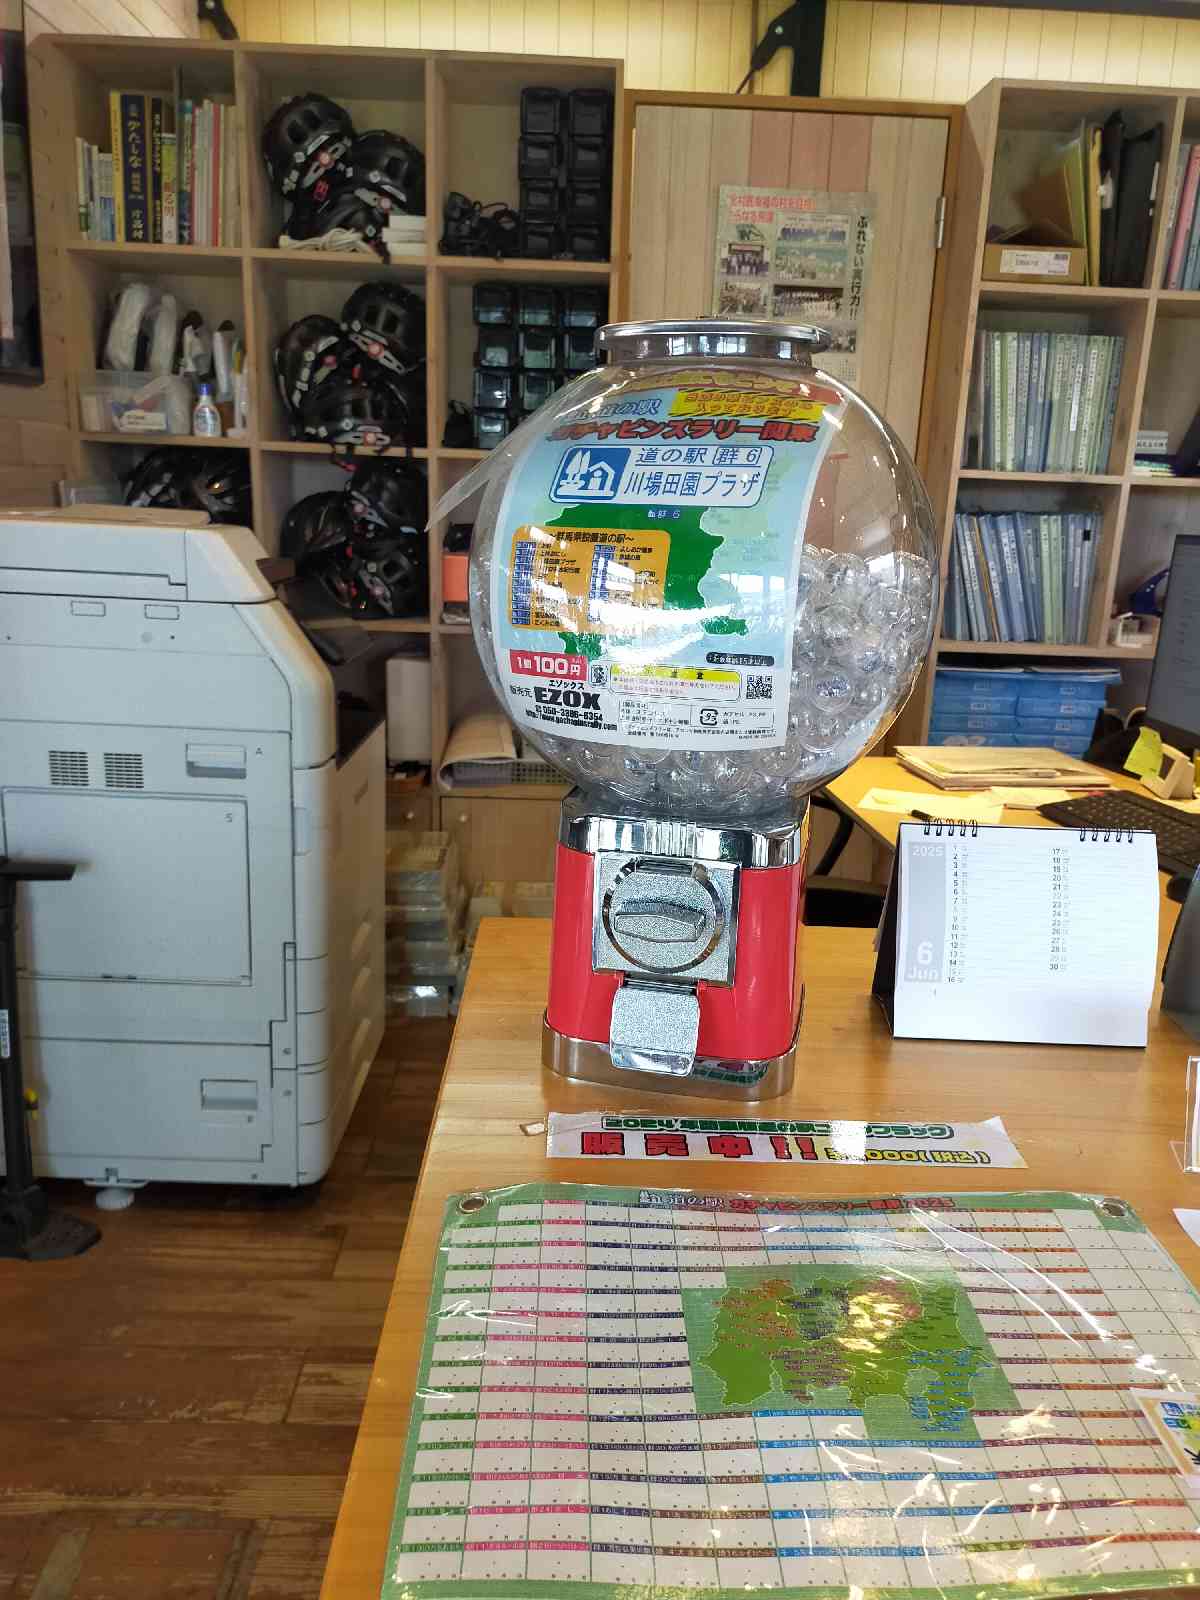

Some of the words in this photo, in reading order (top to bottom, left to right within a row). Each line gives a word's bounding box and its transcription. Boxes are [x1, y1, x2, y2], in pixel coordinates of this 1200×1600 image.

[636, 446, 708, 465] 道の駅
[623, 470, 762, 497] 川場田園プラザ
[533, 686, 601, 711] EZOX
[911, 845, 944, 857] 2025
[916, 940, 933, 966] 6
